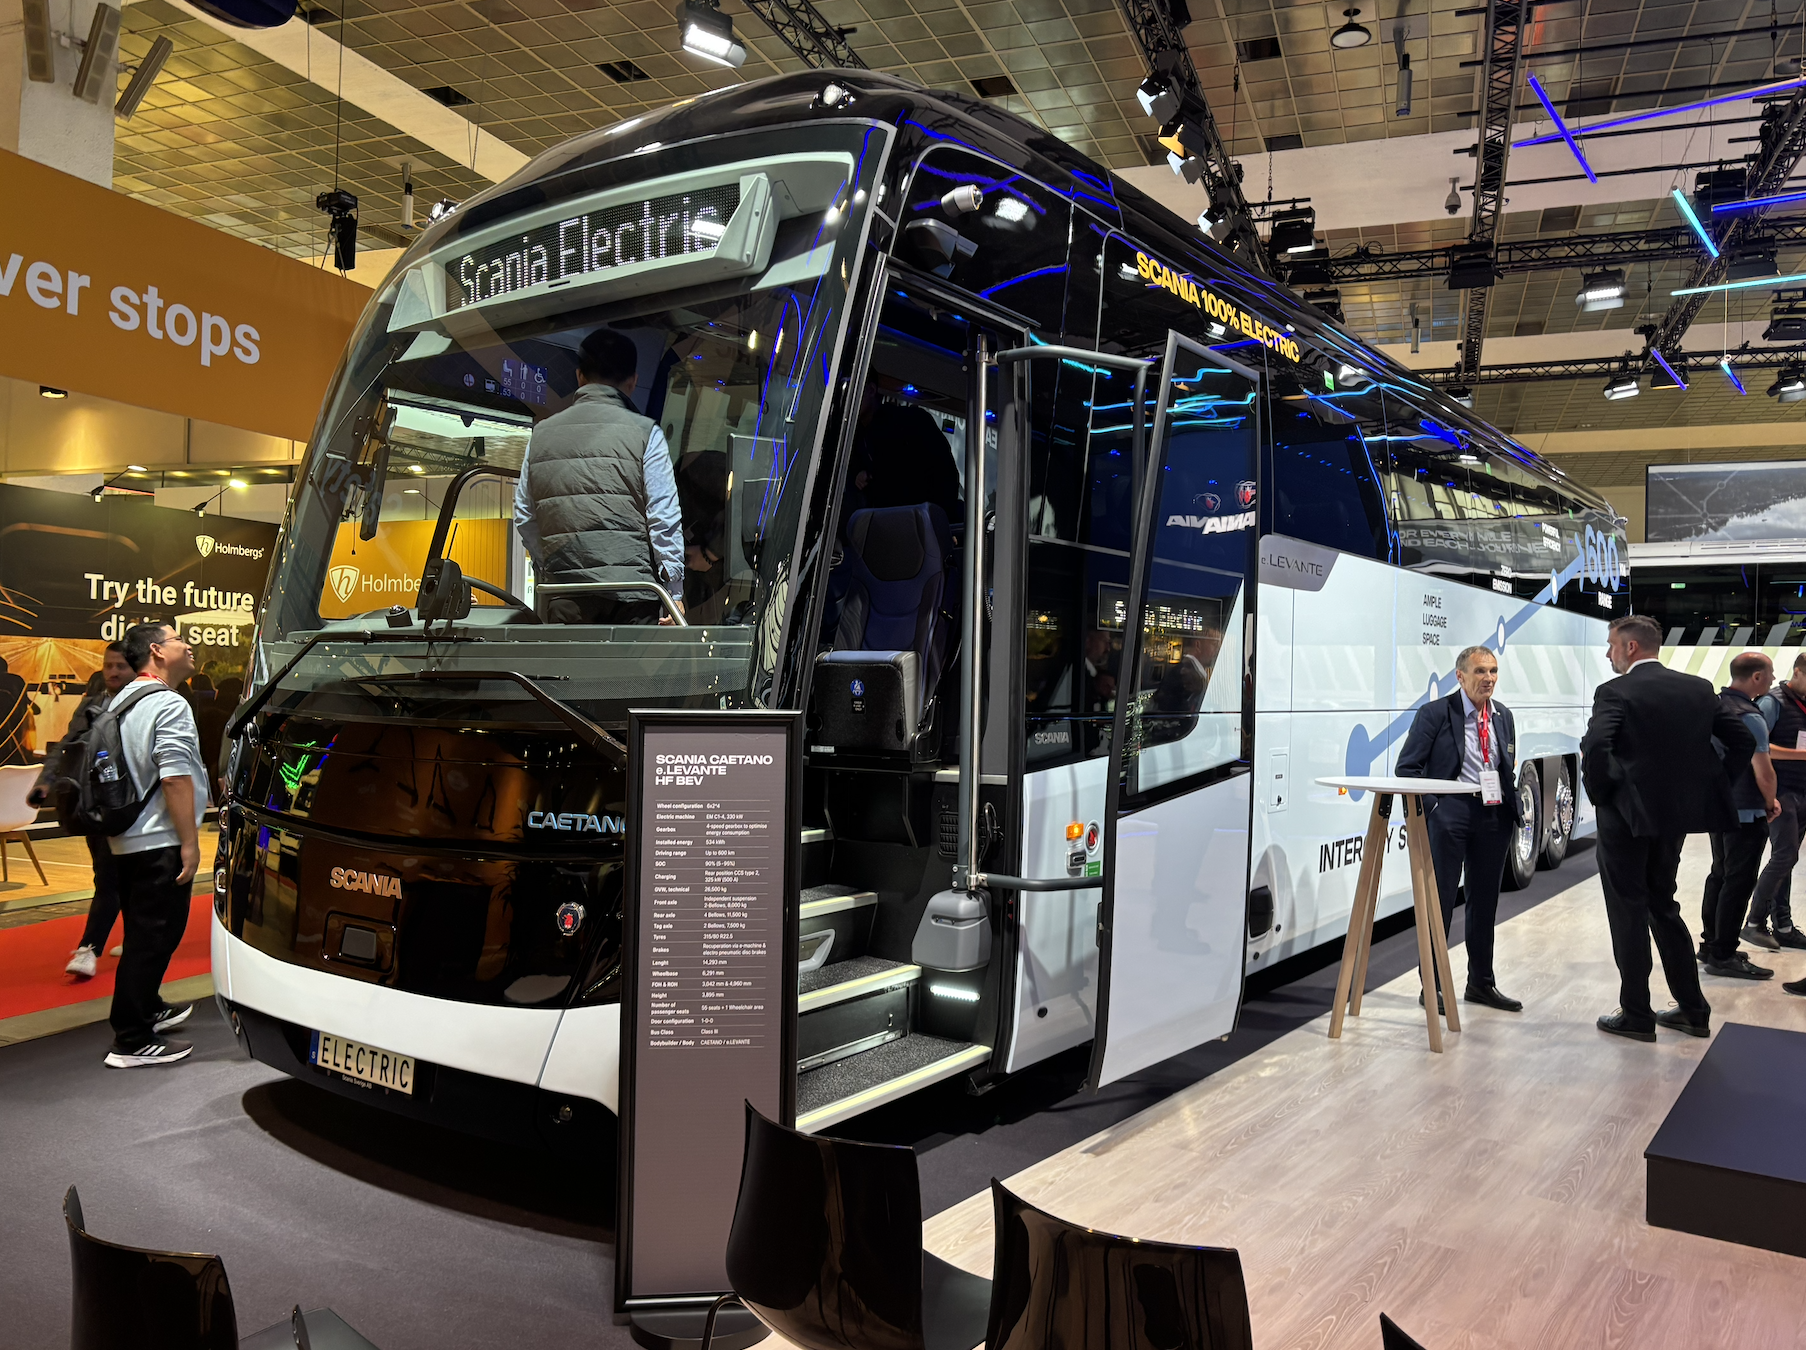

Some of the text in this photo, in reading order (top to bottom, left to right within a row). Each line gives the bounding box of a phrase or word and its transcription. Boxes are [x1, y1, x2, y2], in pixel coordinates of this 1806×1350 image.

[460, 197, 718, 307] Scania Electric
[0, 252, 261, 368] ver stops
[1136, 251, 1300, 363] SCANIA 100% ELECTRIC
[1260, 553, 1323, 577] e.LEVANTE
[1585, 523, 1620, 592] 600
[84, 572, 255, 612] Try the future
[1423, 593, 1442, 609] AMPLE
[1422, 612, 1447, 629] LUGGAGE
[188, 623, 239, 647] seat
[1422, 632, 1440, 646] SPACE
[1034, 731, 1070, 745] SCANIA
[656, 754, 773, 765] SCANIA CAETANO
[656, 766, 726, 775] e.LEVANTE
[655, 776, 703, 785] HF BEV
[527, 811, 626, 834] CAETAN
[1318, 827, 1395, 874] INTERY
[329, 866, 403, 900] SCANIA
[311, 1051, 316, 1059] S
[321, 1036, 410, 1088] ELECTRIC
